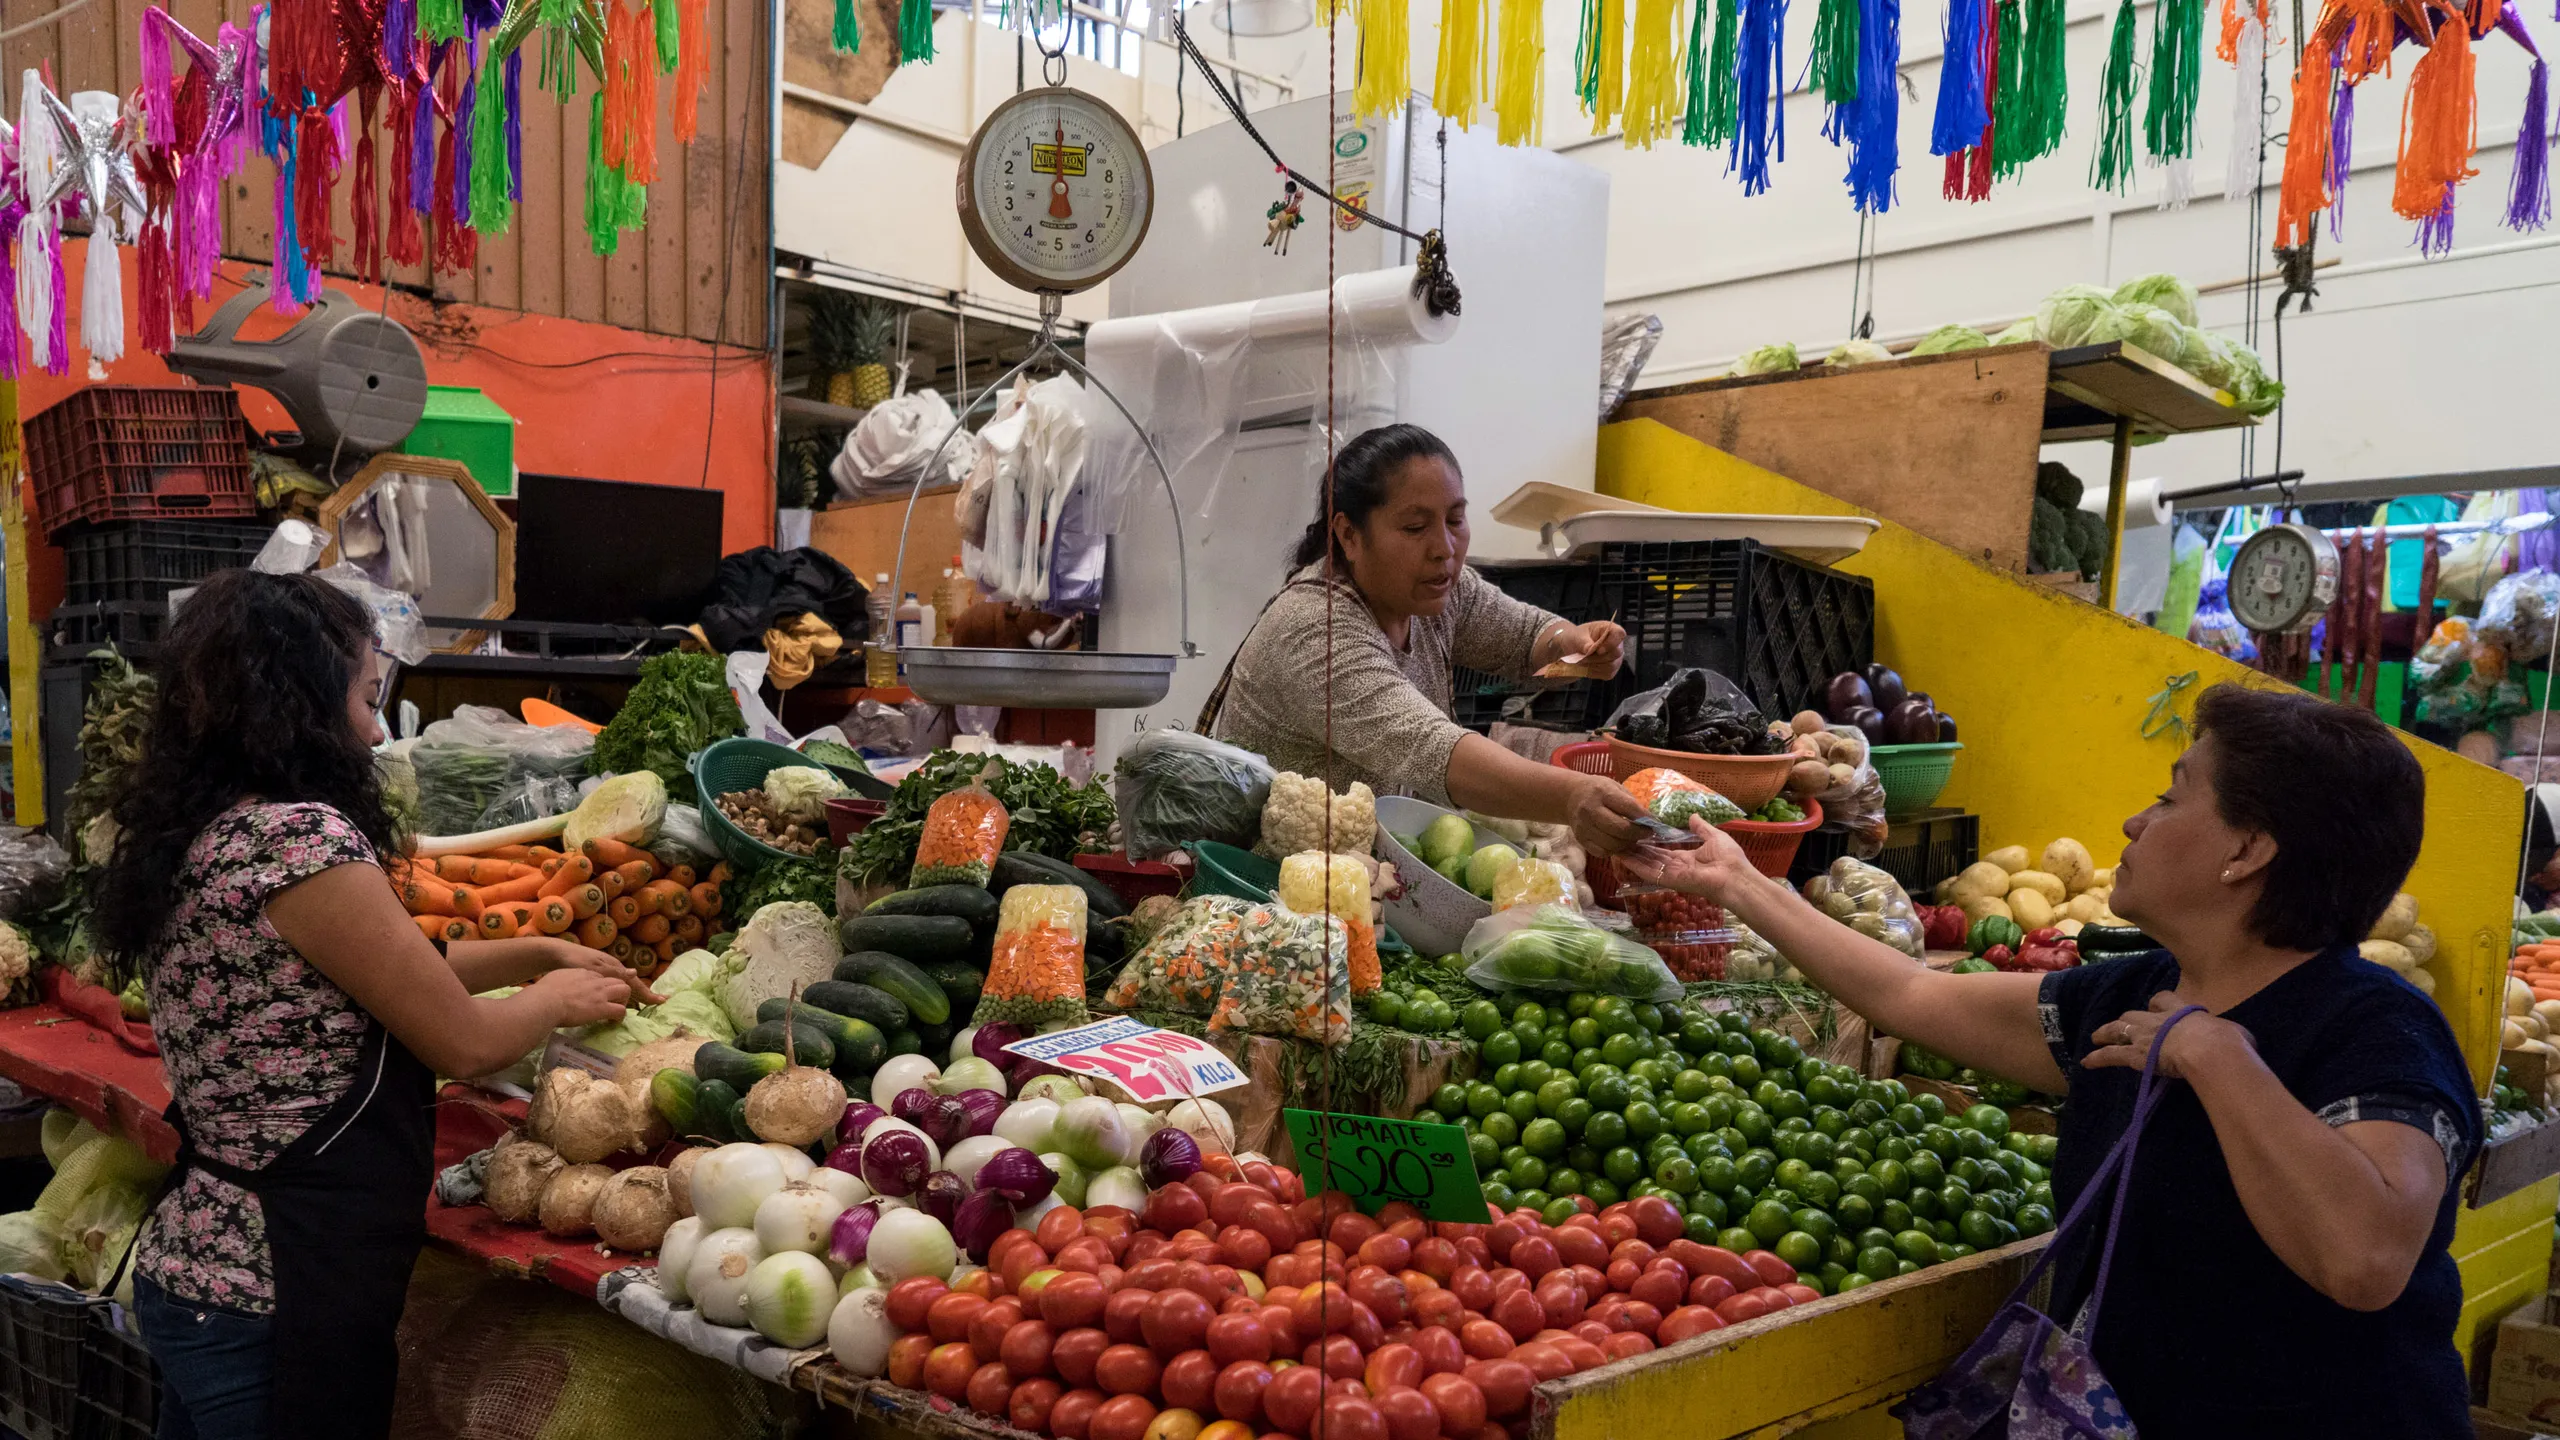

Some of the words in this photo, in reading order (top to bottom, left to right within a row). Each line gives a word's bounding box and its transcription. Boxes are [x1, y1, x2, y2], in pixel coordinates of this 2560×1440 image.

[1085, 142, 1095, 156] 9
[1004, 160, 1014, 174] 2
[1104, 169, 1113, 183] 8
[1004, 196, 1014, 211] 3
[1105, 204, 1113, 219] 7
[1023, 224, 1033, 239] 4
[1085, 229, 1094, 243] 6
[1054, 237, 1063, 251] 5
[1192, 1061, 1236, 1086] KILO
[1306, 1114, 1428, 1147] JITOMATE
